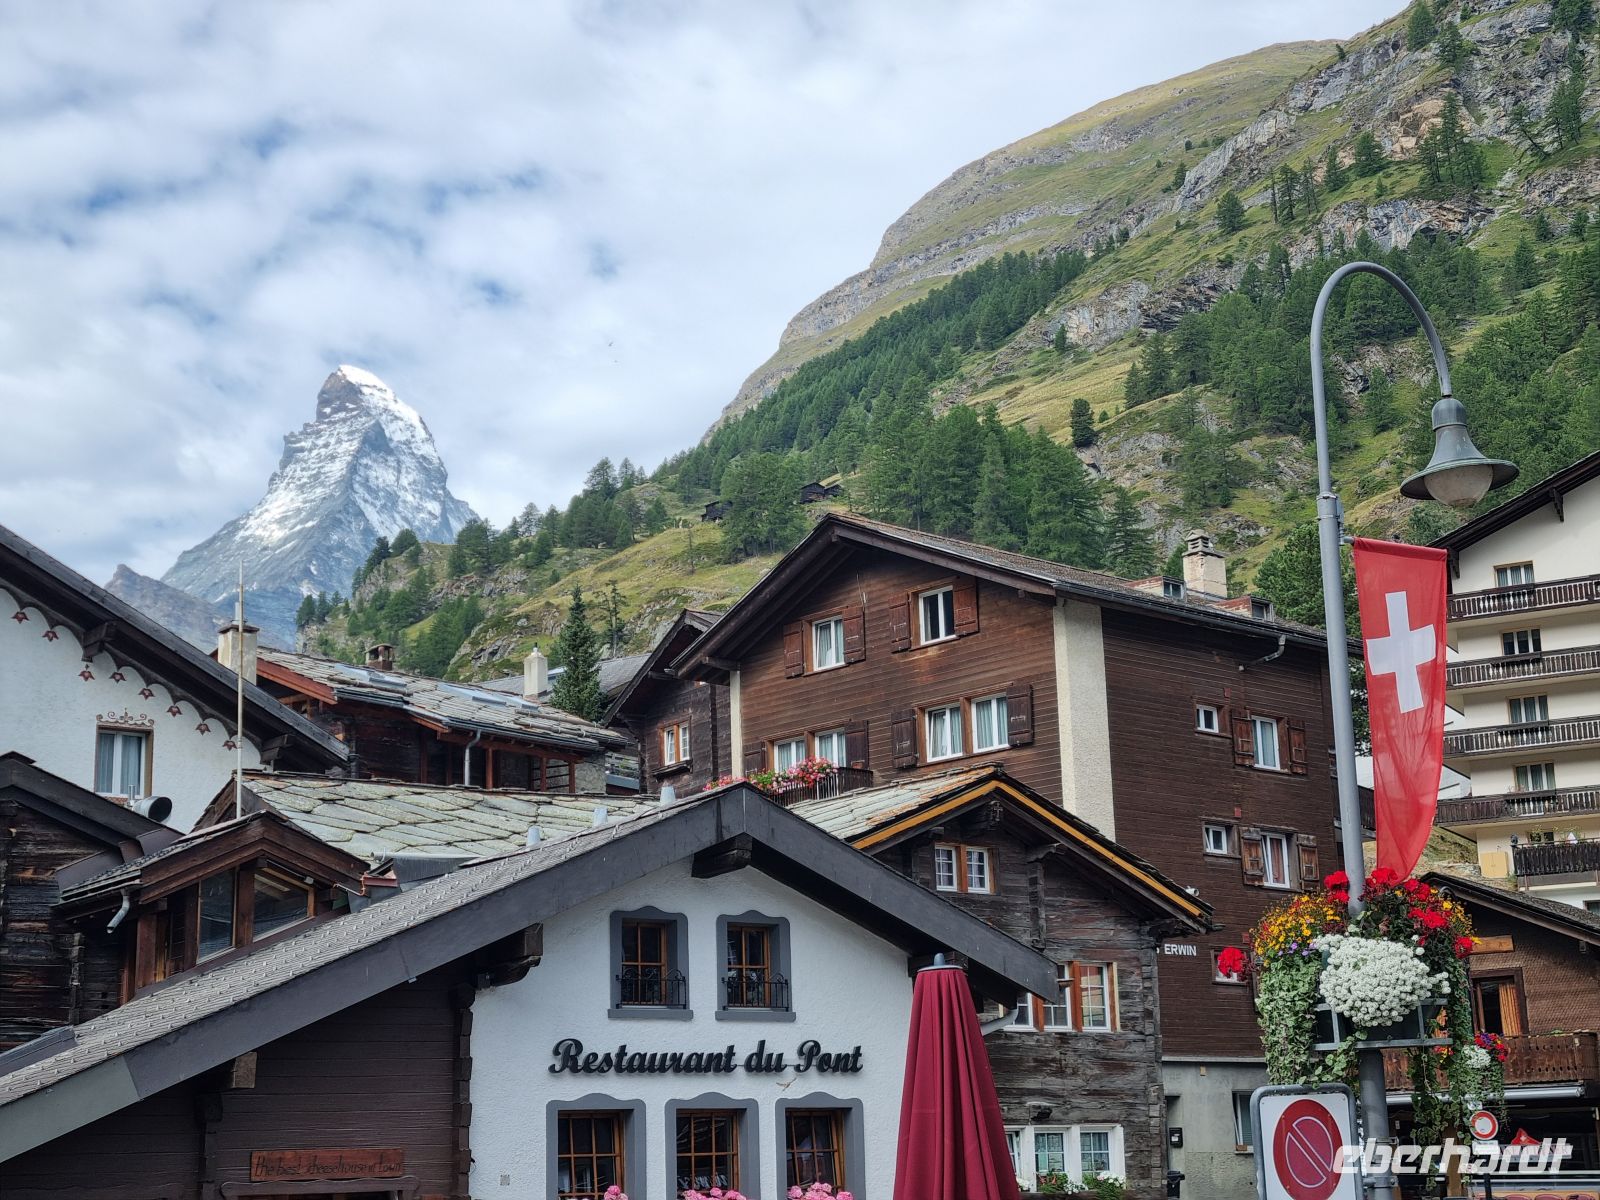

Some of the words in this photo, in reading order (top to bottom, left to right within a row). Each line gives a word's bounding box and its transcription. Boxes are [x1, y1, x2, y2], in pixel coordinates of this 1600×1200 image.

[1164, 943, 1197, 956] ERWIN
[548, 1038, 737, 1074] Restaurant
[744, 1039, 787, 1073] du
[794, 1039, 863, 1074] Pont
